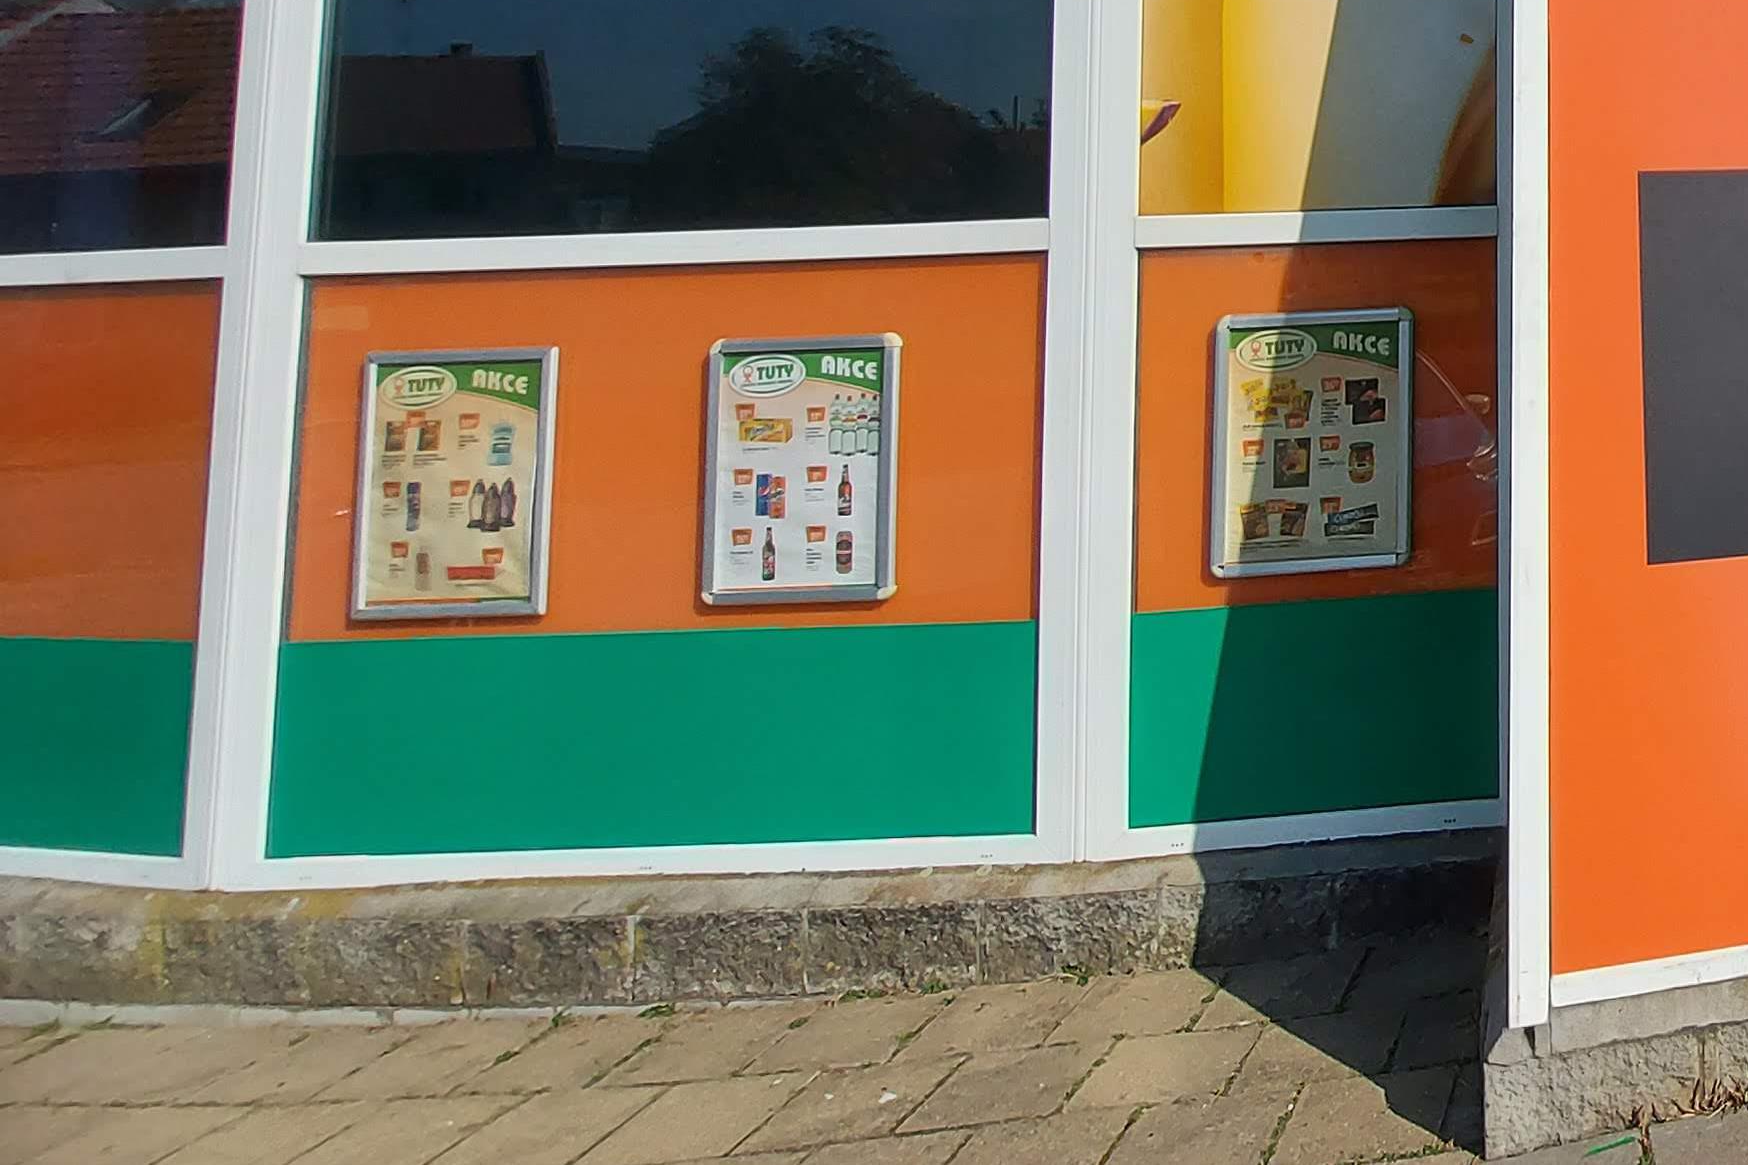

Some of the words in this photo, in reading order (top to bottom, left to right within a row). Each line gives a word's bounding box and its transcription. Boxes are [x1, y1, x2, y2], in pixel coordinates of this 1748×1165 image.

[1264, 339, 1305, 356] TUTY
[1332, 330, 1390, 356] AKCE
[756, 363, 794, 381] TUTY
[821, 355, 879, 381] AKCE
[407, 376, 446, 393] TUTY
[472, 369, 529, 395] AKCE
